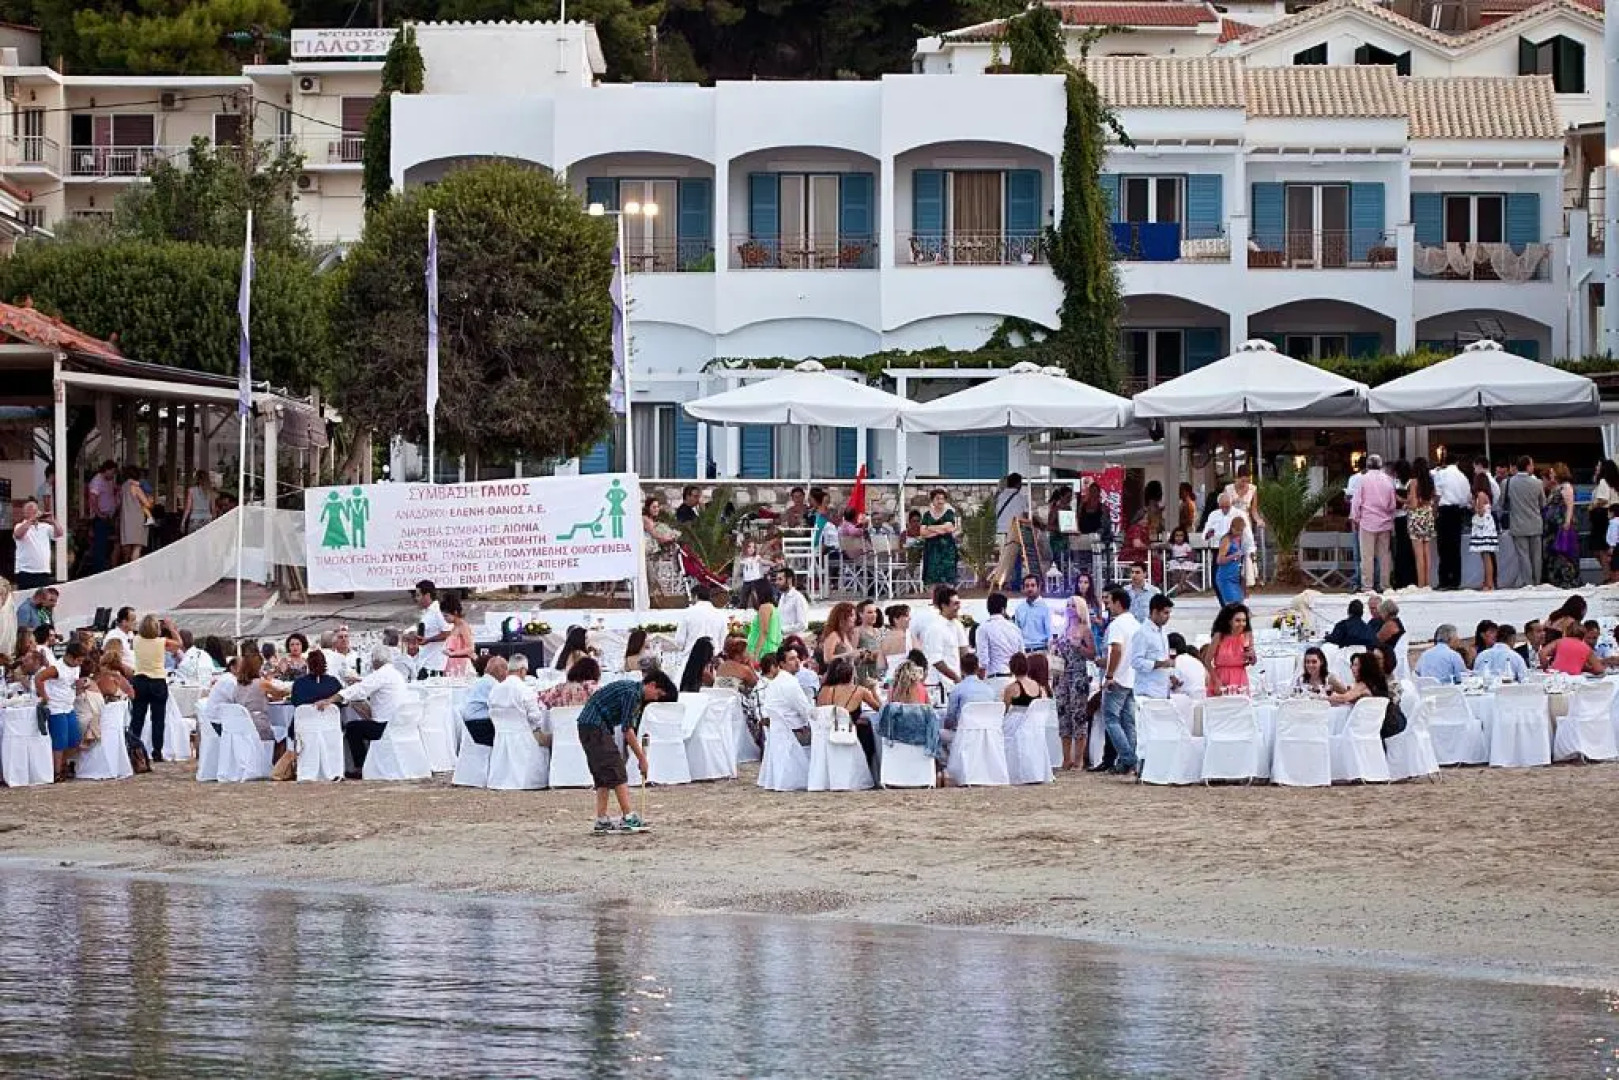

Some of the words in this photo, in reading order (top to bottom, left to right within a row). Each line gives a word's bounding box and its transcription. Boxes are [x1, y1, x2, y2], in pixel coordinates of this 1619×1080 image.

[409, 486, 479, 500] ΣΥΜΒΑΣΗ:
[481, 484, 530, 497] ΓΑΜΟΣ
[527, 504, 547, 514] Α.Ε.
[401, 527, 443, 538] ΔΙΑΡΚΕΙΑ
[446, 524, 500, 535] ΣΥΜΒΑΣΗΣ:
[398, 540, 419, 550] ΑΞΙΑ
[420, 537, 475, 549] ΣΥΜΒΑΣΗΣ:
[479, 534, 546, 547] ΑΝΕΚΤΙΜΗΤΗ
[382, 552, 428, 563] ΣΥΝΕΧΗΣ
[504, 546, 569, 557] ΠΟΛΥΜΕΛΗΣ
[571, 543, 632, 555] ΟΙΚΟΓΕΝΕΙΑ
[366, 565, 393, 577] ΛΥΣΗ
[452, 562, 479, 573] ΠΟΤΕ
[537, 557, 580, 570] ΑΠΕΙΡΕΣ
[460, 572, 486, 584] ΕΙΝΑΙ
